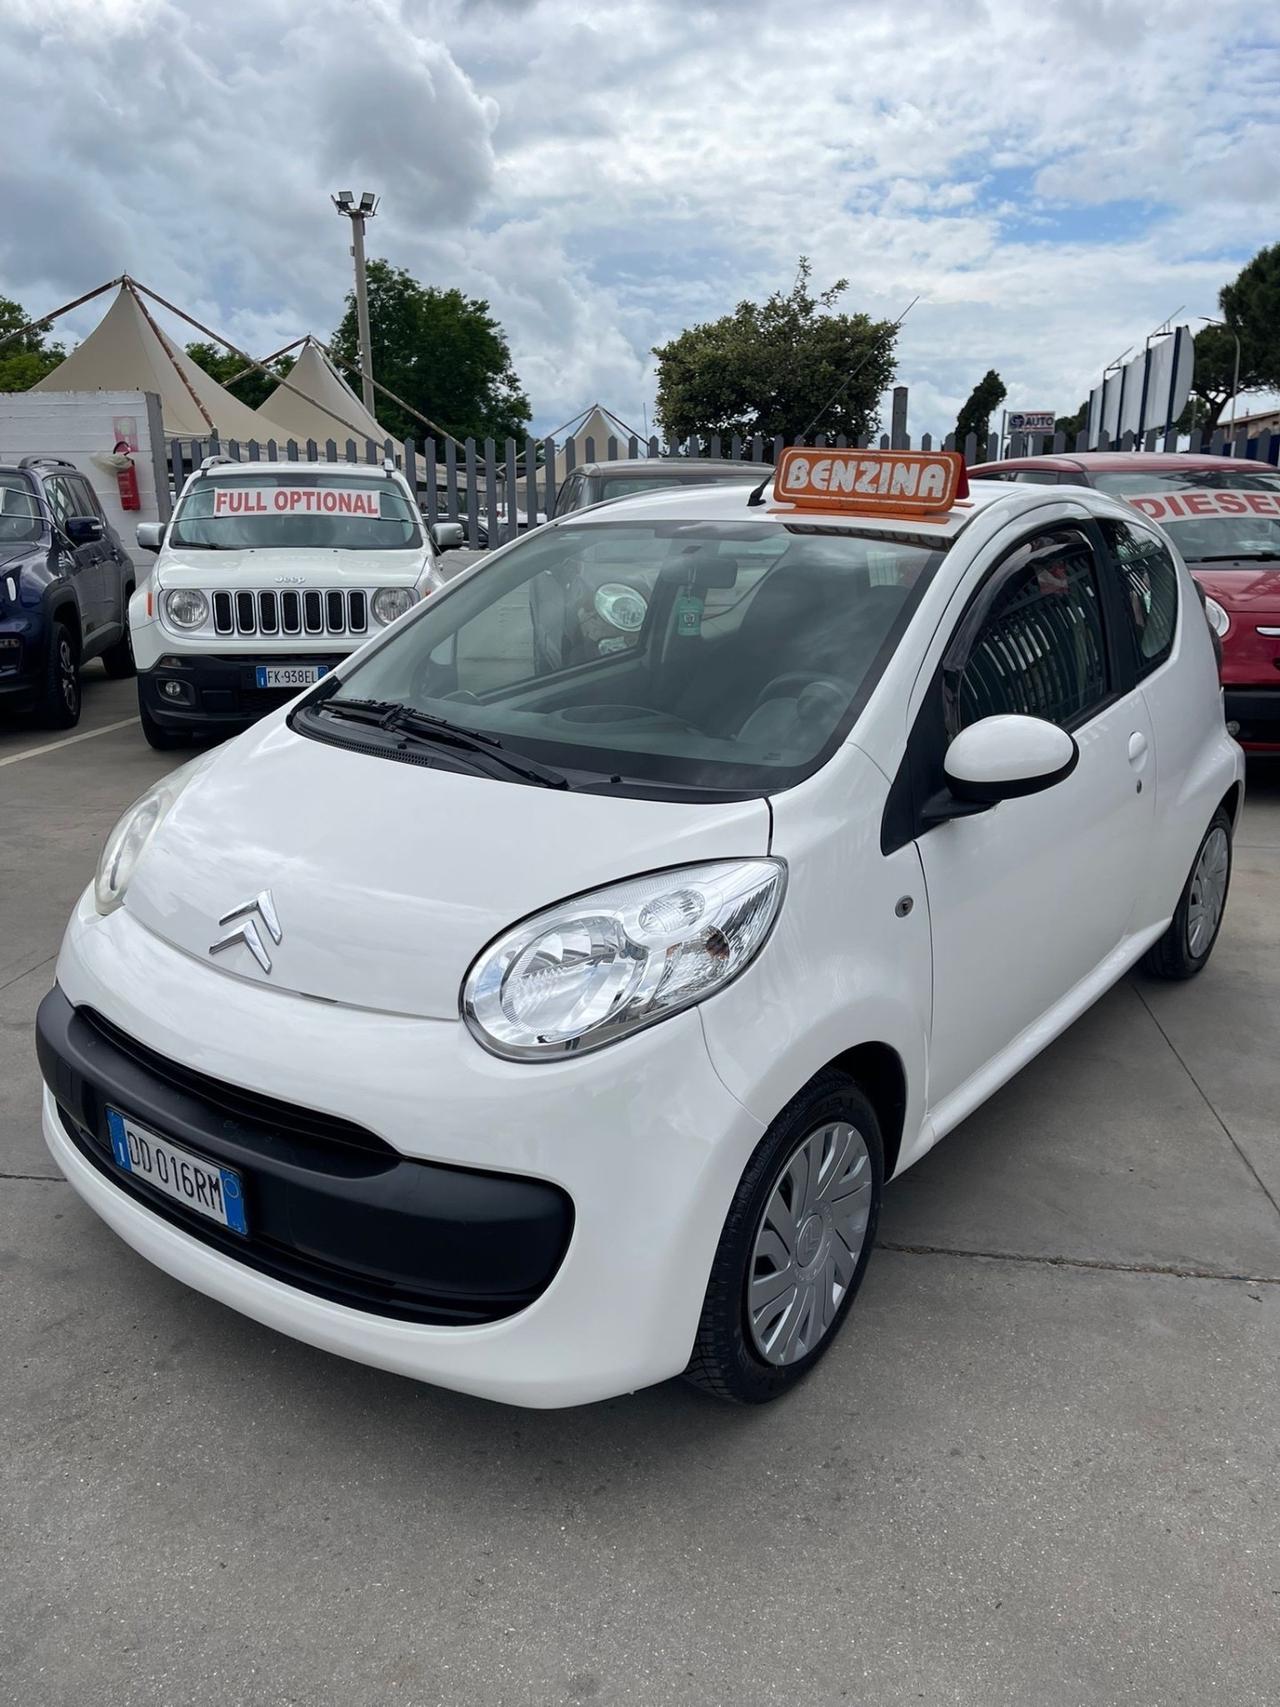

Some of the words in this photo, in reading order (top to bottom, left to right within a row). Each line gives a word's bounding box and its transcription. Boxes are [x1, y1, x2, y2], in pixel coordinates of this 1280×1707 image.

[1025, 416, 1054, 426] AUTO
[786, 457, 946, 498] BENZINA
[216, 491, 267, 513] FULL
[274, 491, 378, 514] OPTIONAL
[274, 576, 306, 585] Jeep
